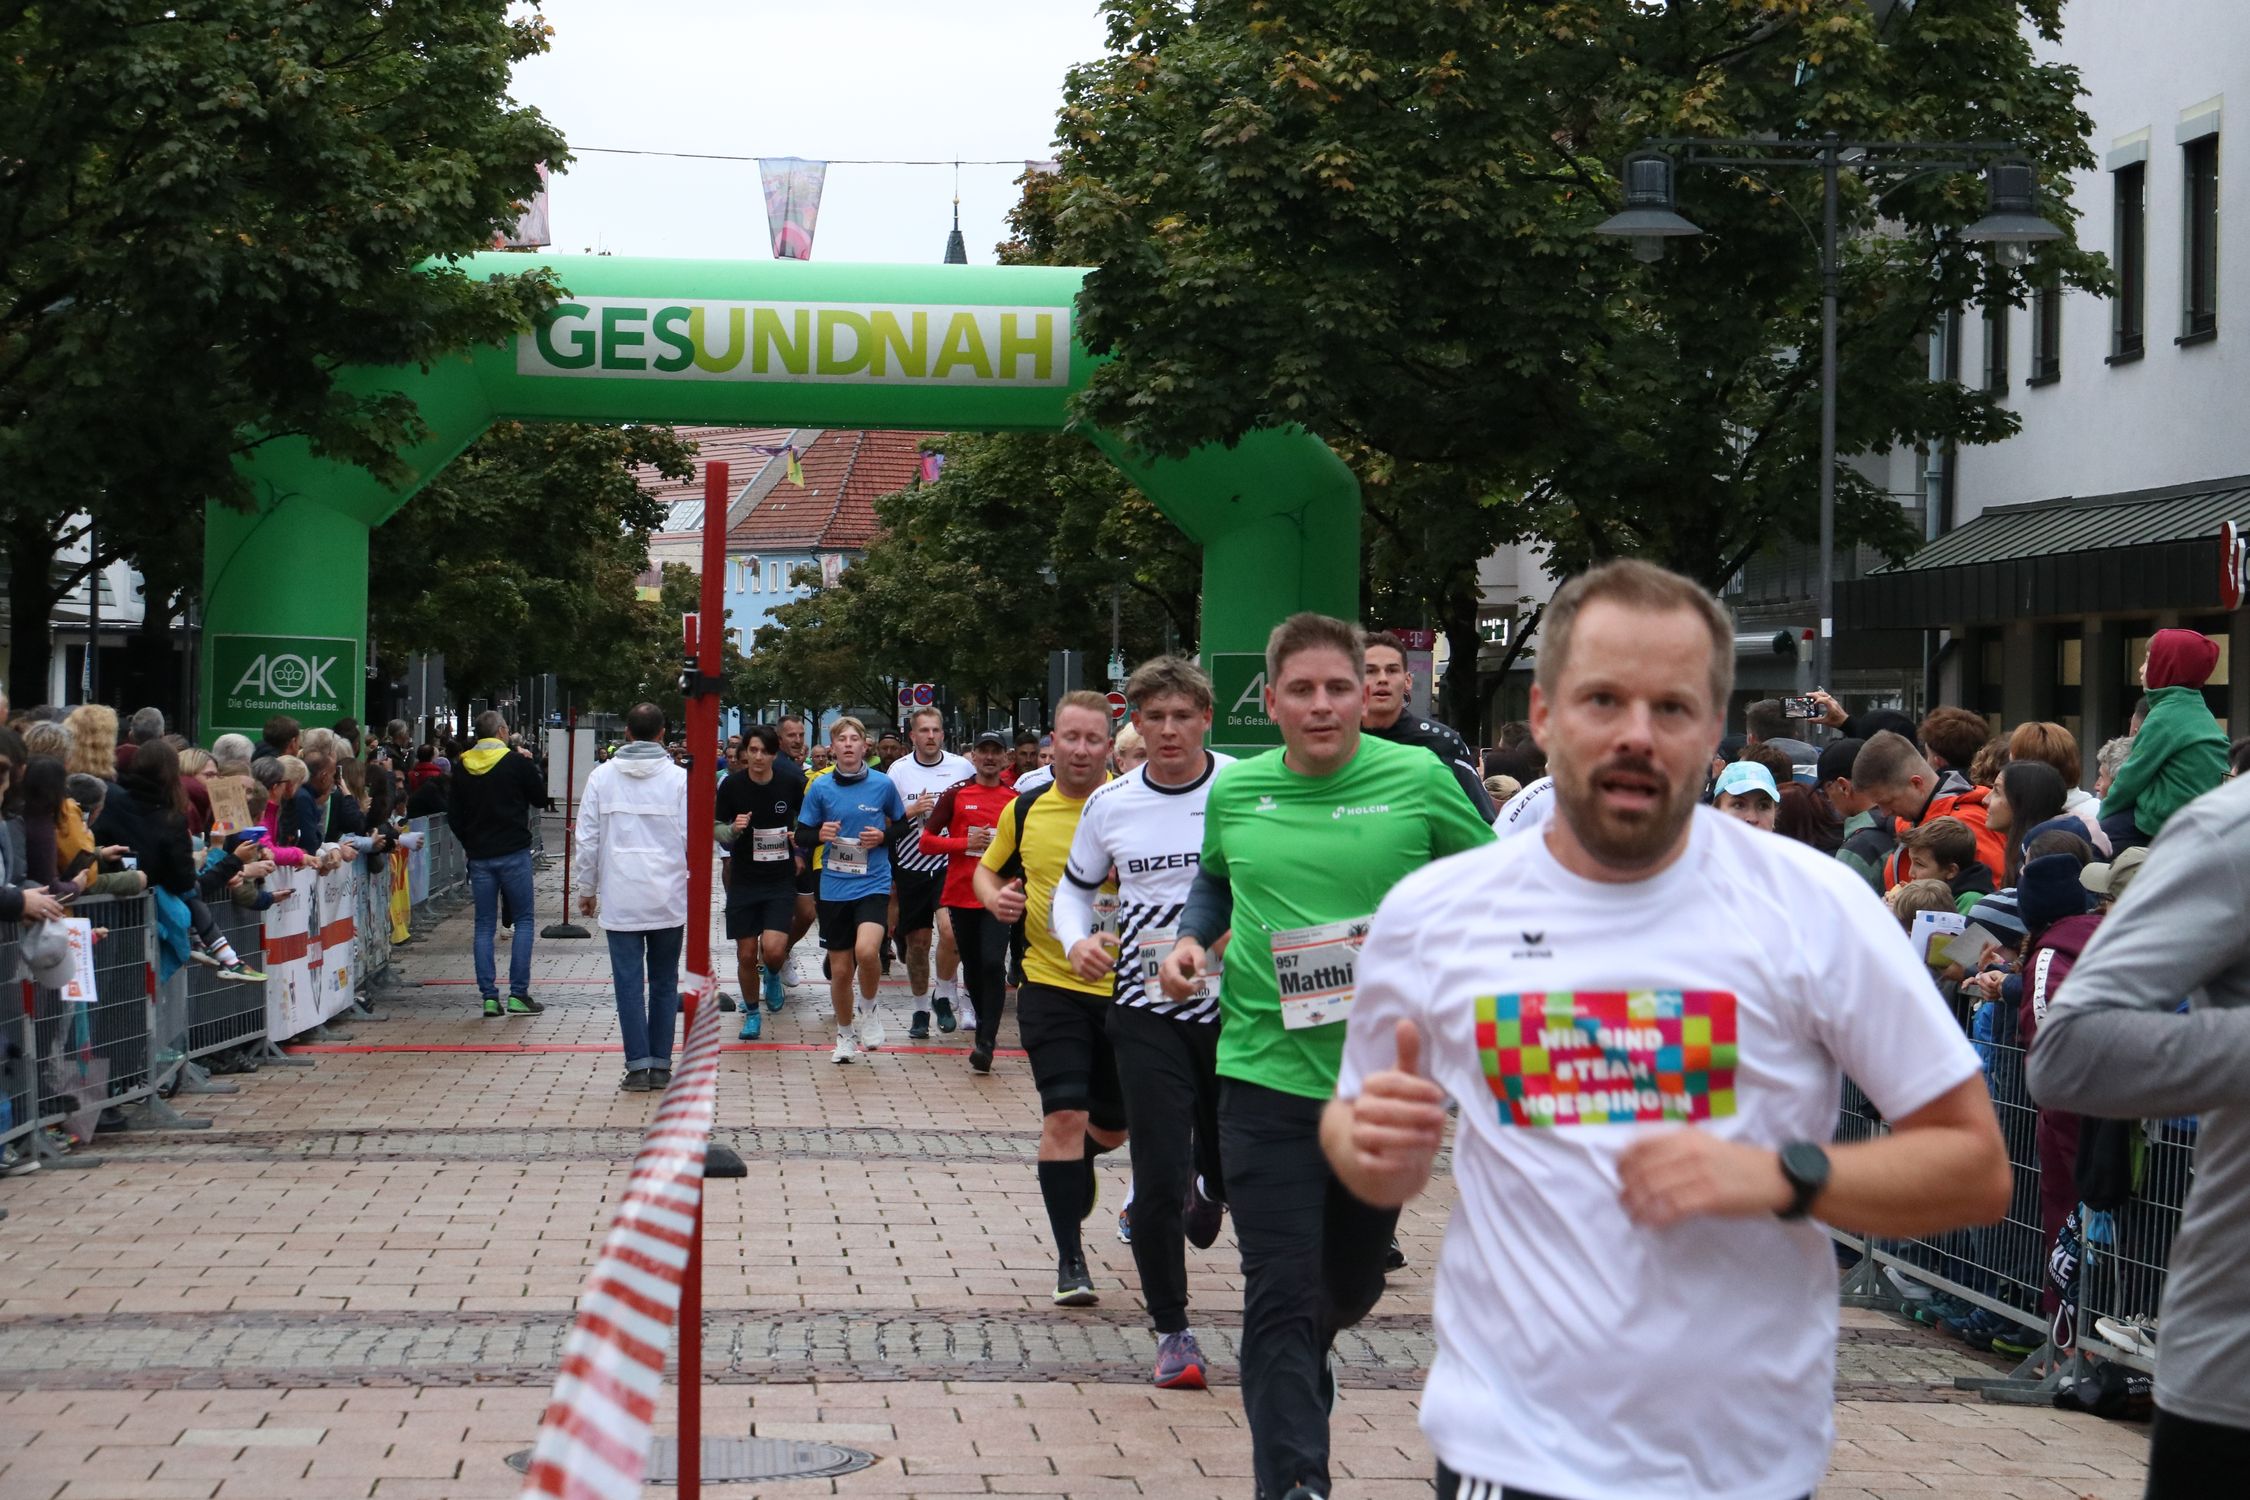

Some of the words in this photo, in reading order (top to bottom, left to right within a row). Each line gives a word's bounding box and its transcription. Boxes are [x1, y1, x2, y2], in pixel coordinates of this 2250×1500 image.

[535, 303, 1053, 380] GESUNDNAH
[231, 653, 337, 698] AOK
[228, 698, 241, 709] Die
[244, 699, 339, 711] Gesundheitskasse.
[1228, 716, 1242, 725] Die
[1347, 804, 1389, 816] HOLCIM
[756, 841, 785, 851] Samuel
[1141, 948, 1156, 958] 460
[1276, 955, 1299, 969] 957
[1538, 1028, 1589, 1049] WIR
[1596, 1028, 1664, 1050] SIND
[1556, 1060, 1649, 1081] #TEAM
